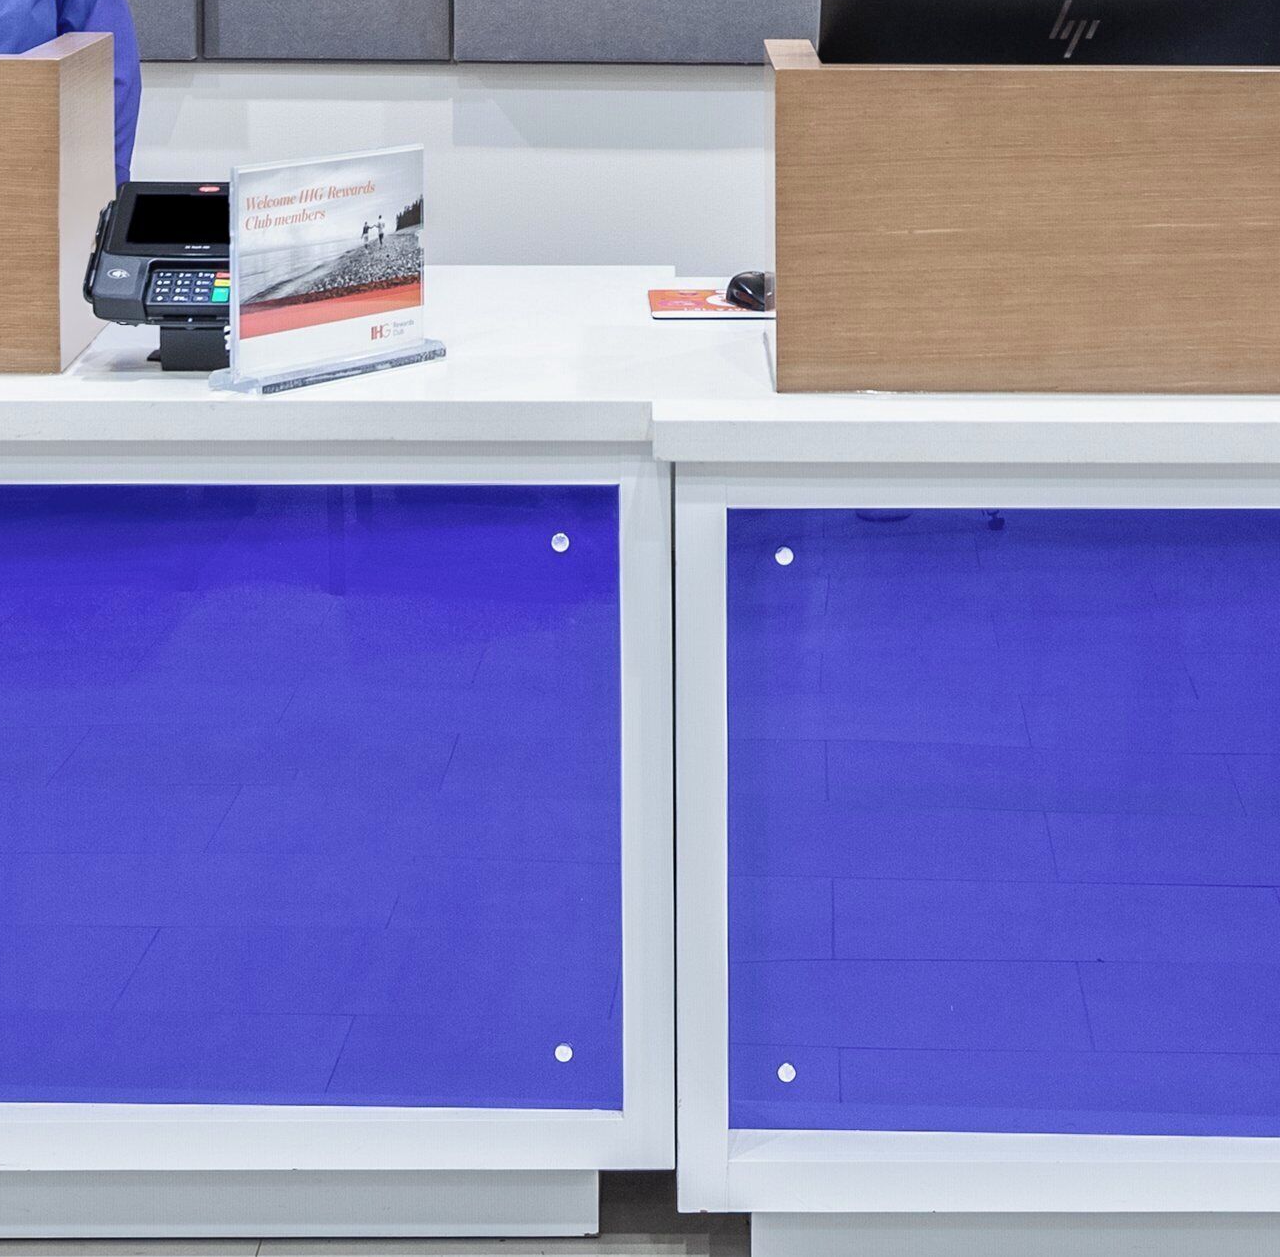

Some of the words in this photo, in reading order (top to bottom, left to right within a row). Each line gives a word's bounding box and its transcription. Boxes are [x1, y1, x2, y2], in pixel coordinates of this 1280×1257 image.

[1049, 0, 1101, 58] hp
[245, 194, 297, 211] Welcome
[299, 187, 324, 204] IHG
[327, 180, 376, 199] Rewards
[245, 214, 272, 231] Club
[274, 208, 326, 226] members
[371, 323, 391, 340] IHG
